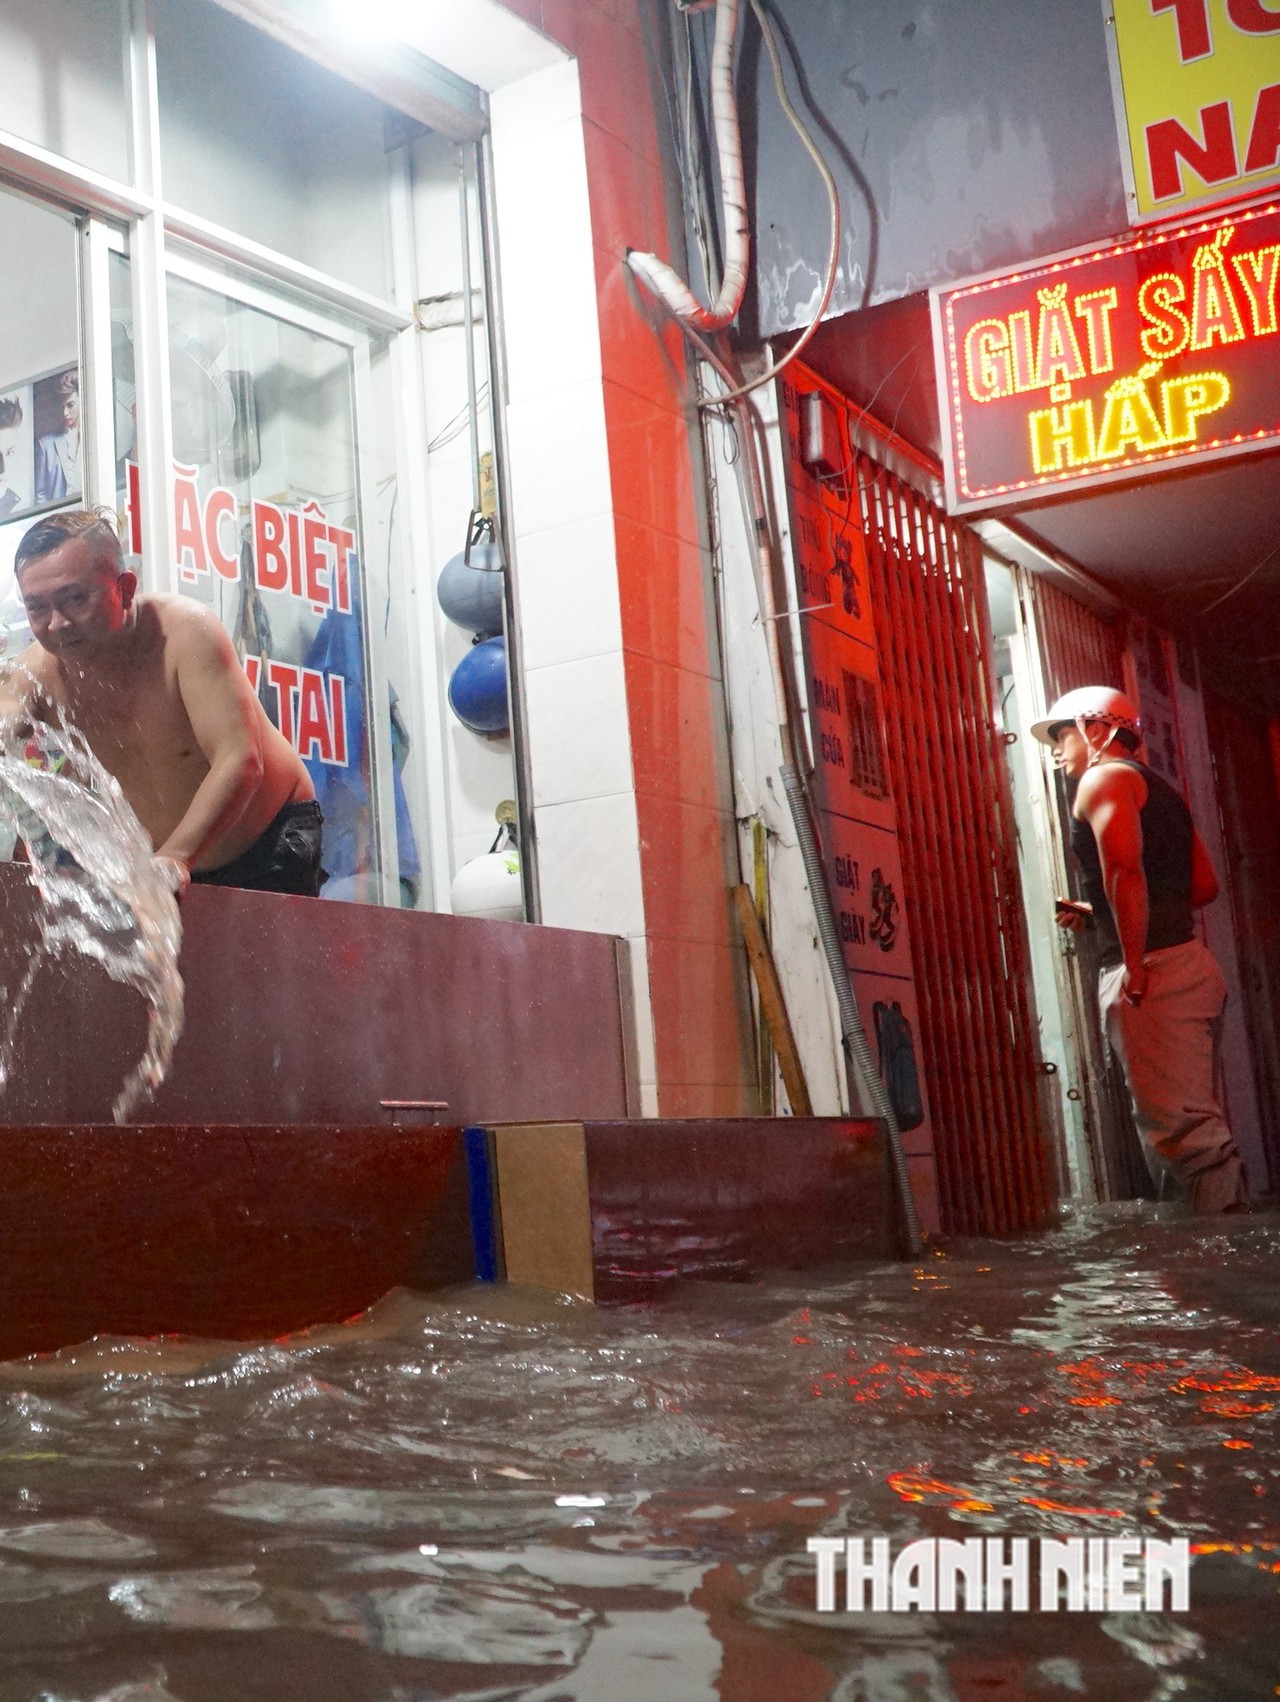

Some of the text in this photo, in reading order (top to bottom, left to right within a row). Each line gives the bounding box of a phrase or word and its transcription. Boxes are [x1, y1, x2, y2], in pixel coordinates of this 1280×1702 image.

[964, 226, 1280, 403] GIẶT SẤY
[1028, 360, 1231, 475] HẤP
[254, 501, 354, 614] BIỆT
[271, 664, 346, 764] TAI
